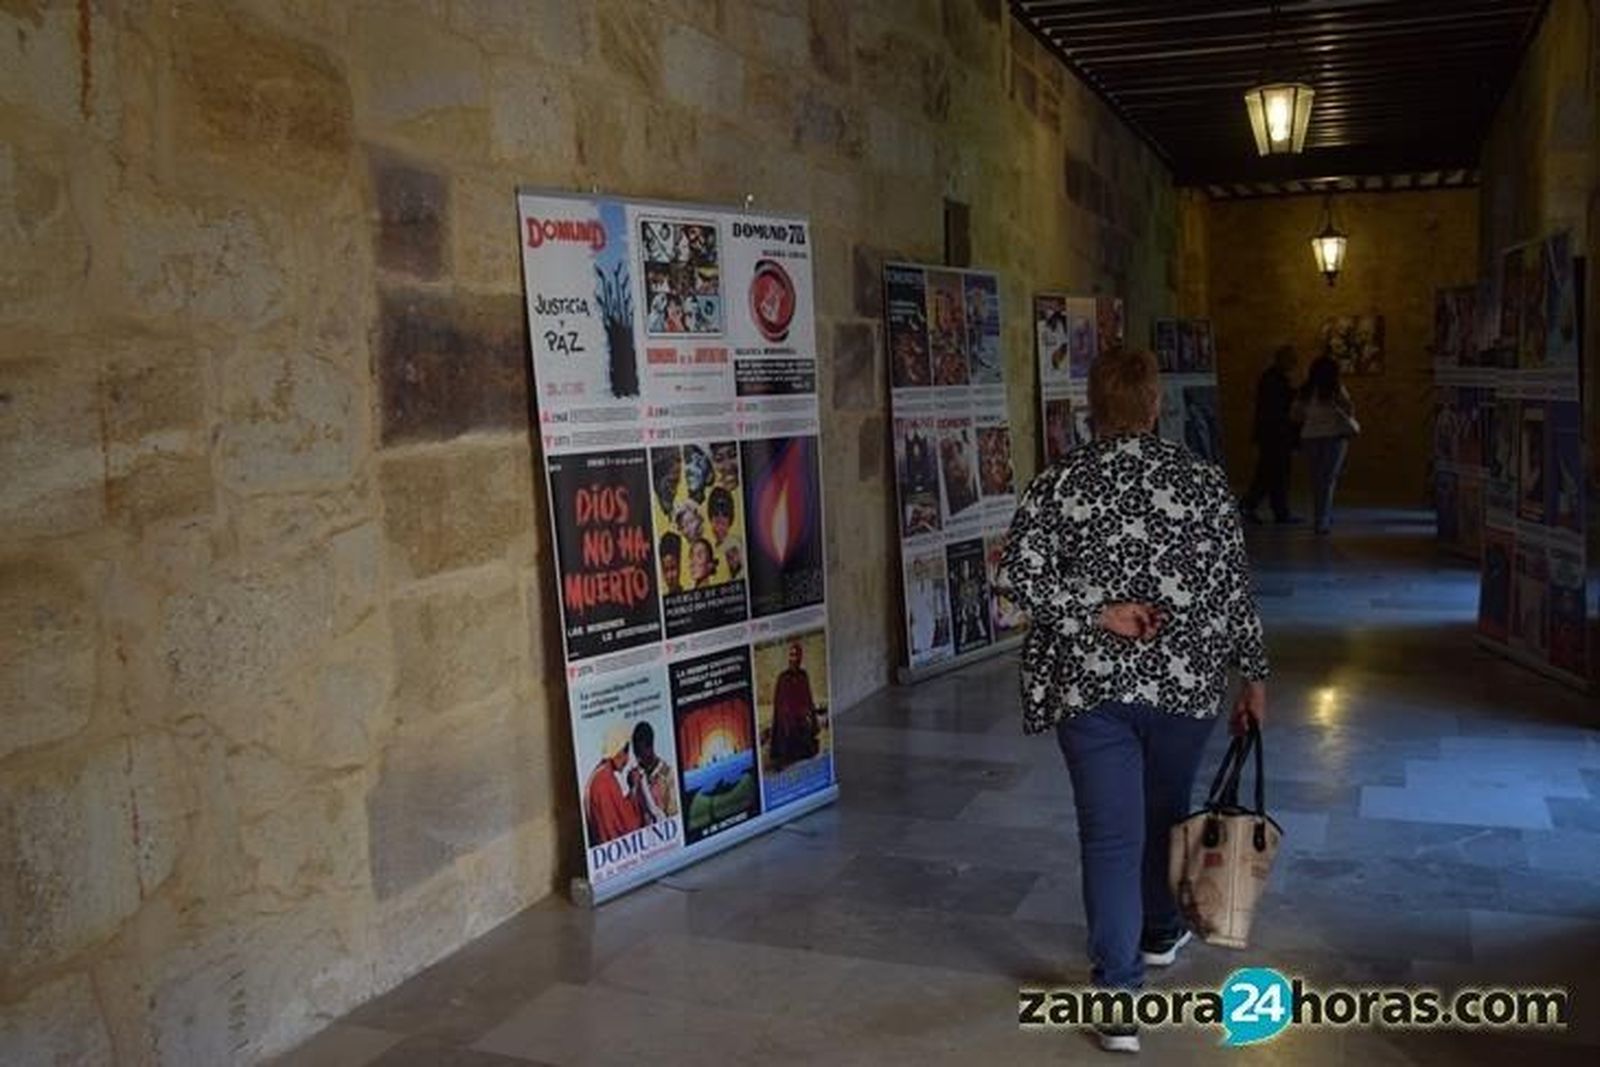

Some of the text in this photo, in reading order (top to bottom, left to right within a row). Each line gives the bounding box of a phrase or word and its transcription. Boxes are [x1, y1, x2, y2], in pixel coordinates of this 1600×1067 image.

[526, 217, 607, 252] DOMUND
[535, 293, 590, 316] JUSTICIA
[544, 330, 584, 355] PAZ
[576, 484, 629, 526] DIOS
[583, 528, 614, 567] NO
[565, 566, 649, 615] MUERTO
[593, 819, 678, 869] DOMUND
